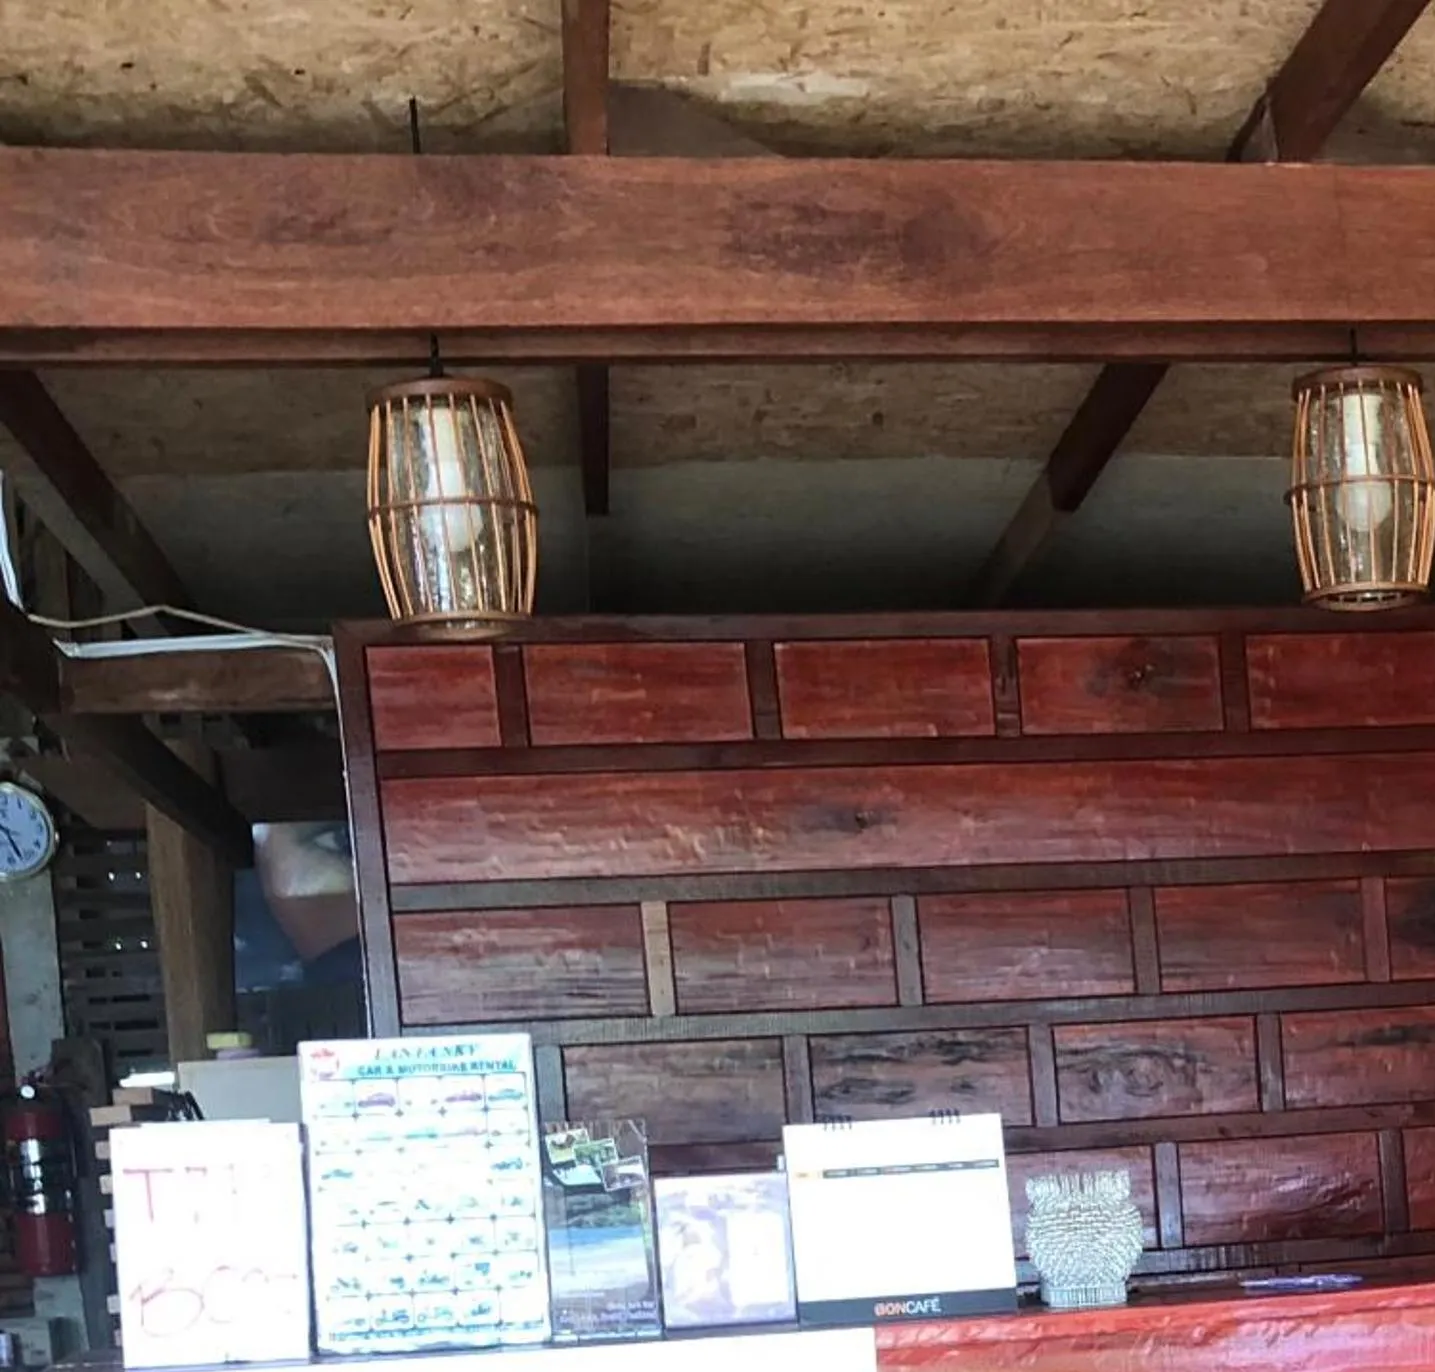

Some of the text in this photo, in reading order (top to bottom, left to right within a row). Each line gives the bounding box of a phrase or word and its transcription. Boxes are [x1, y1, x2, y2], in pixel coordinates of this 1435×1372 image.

[357, 1064, 382, 1076] CAR
[397, 1062, 468, 1074] MOTORBIKE
[470, 1060, 515, 1071] RENTAL
